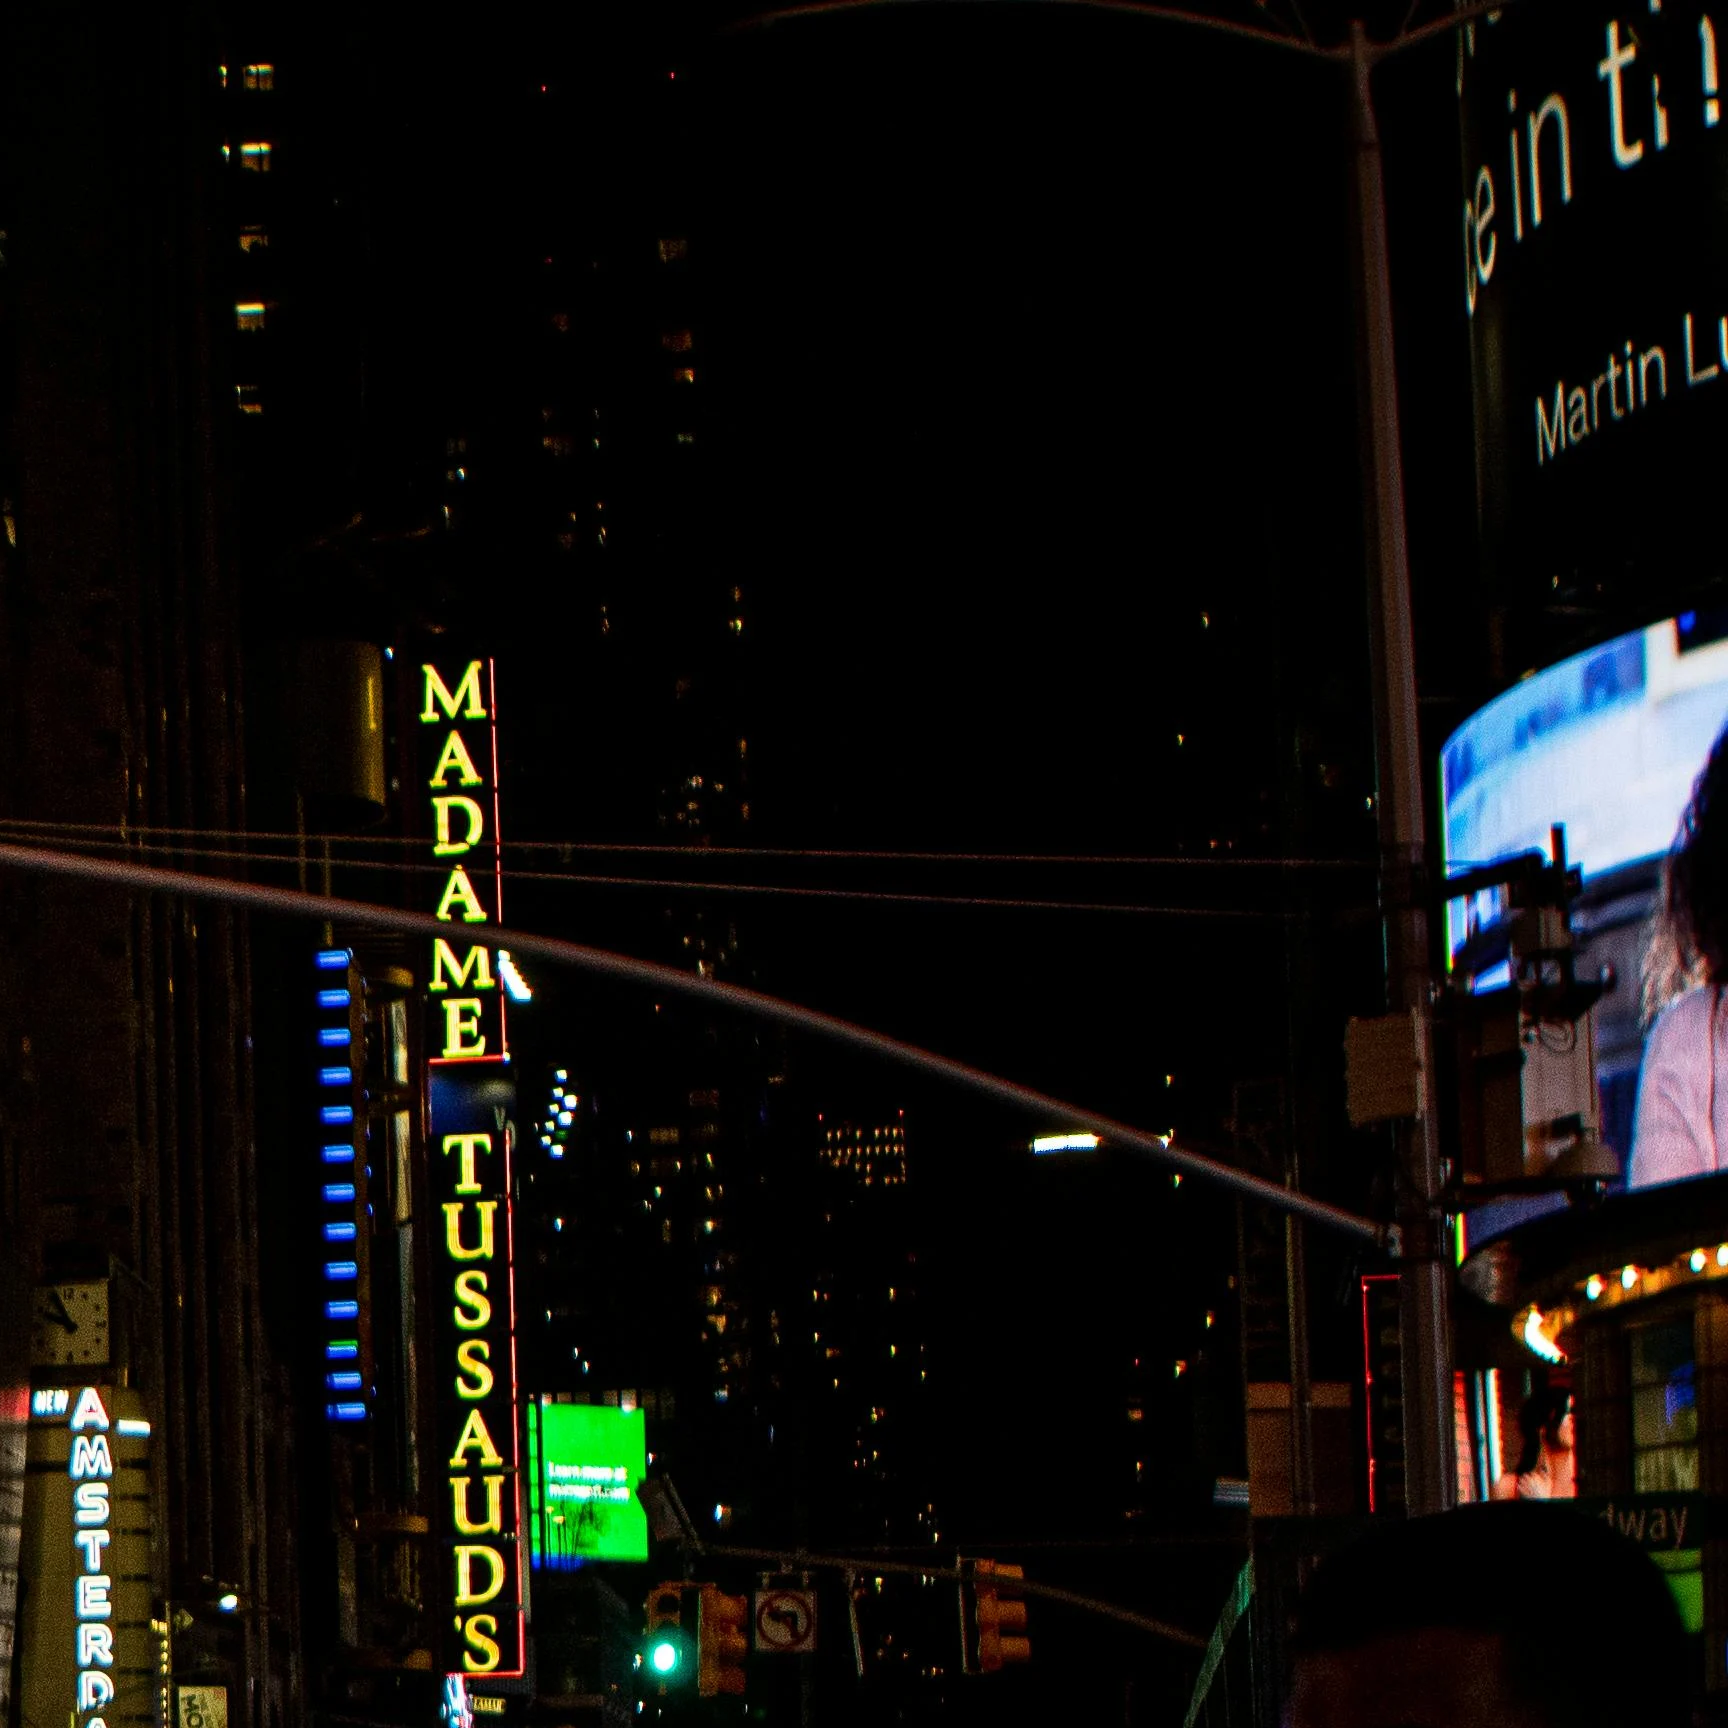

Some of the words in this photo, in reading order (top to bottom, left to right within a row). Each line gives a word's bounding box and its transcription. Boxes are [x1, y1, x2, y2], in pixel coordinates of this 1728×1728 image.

[1506, 86, 1574, 244] in
[1534, 336, 1667, 468] Martin
[420, 660, 494, 1058] MADAME
